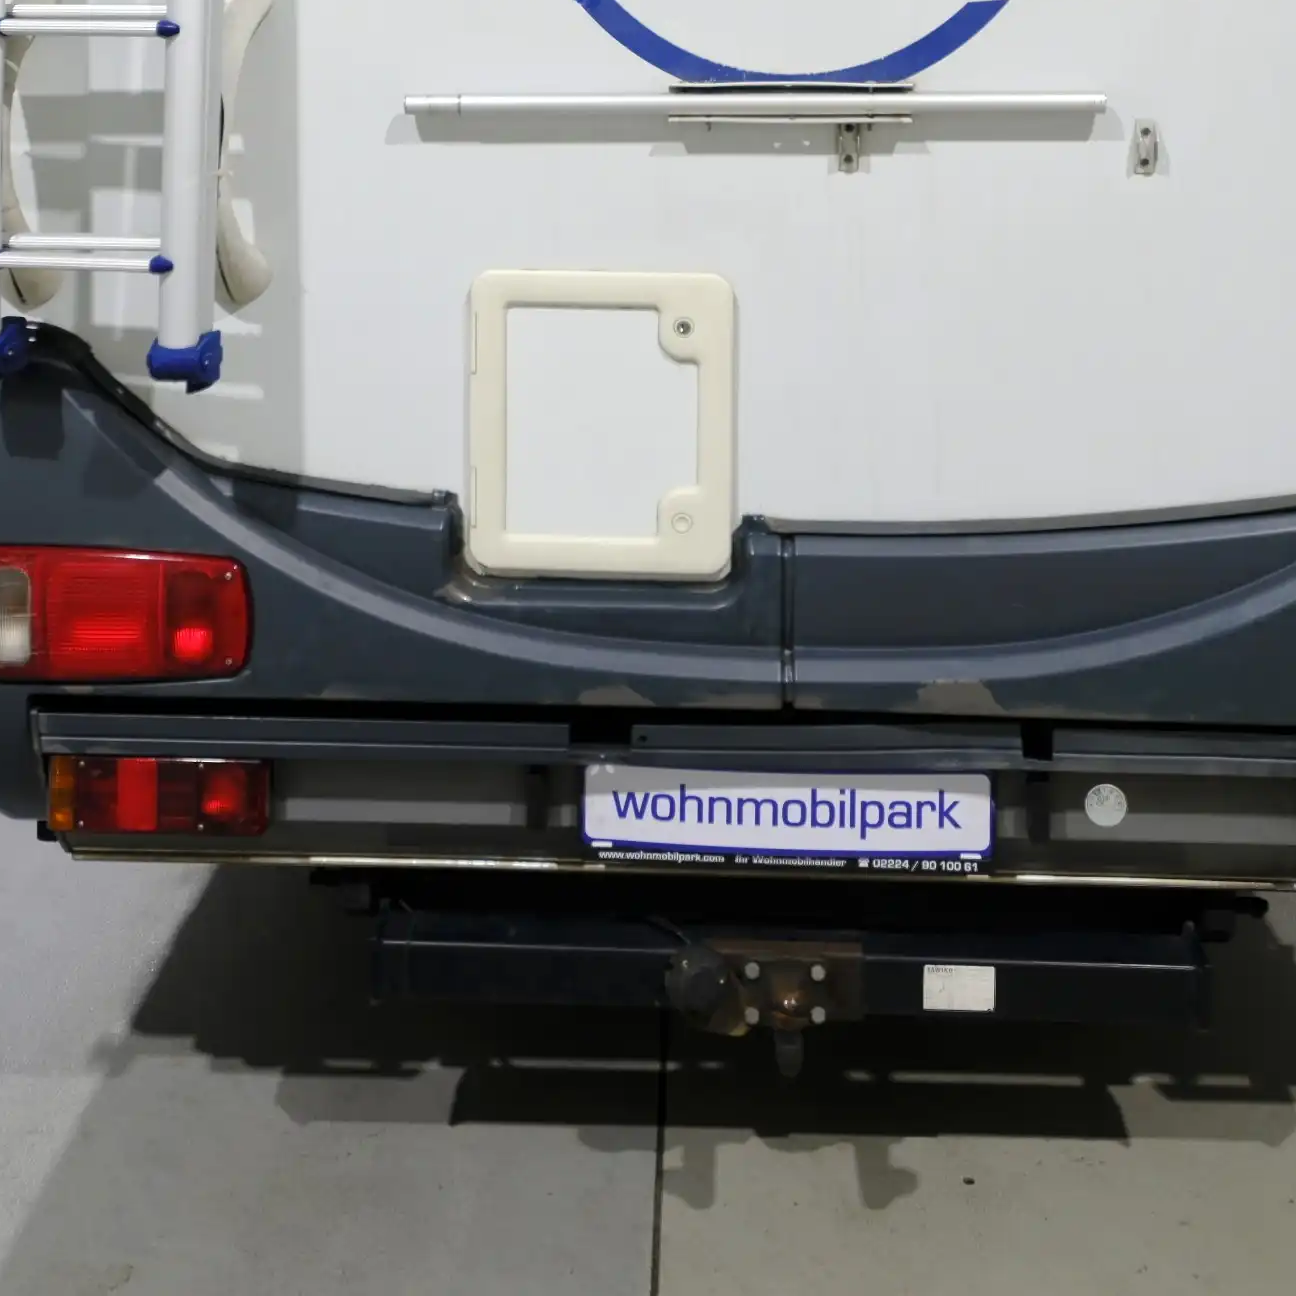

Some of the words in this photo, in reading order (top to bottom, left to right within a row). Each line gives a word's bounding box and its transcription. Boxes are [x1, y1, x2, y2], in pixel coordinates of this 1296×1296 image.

[612, 784, 961, 840] wohnmobilpark
[598, 851, 725, 864] www.wohnmobilpark.com
[872, 859, 910, 870] 02224
[940, 861, 962, 872] 100
[963, 862, 979, 873] 61
